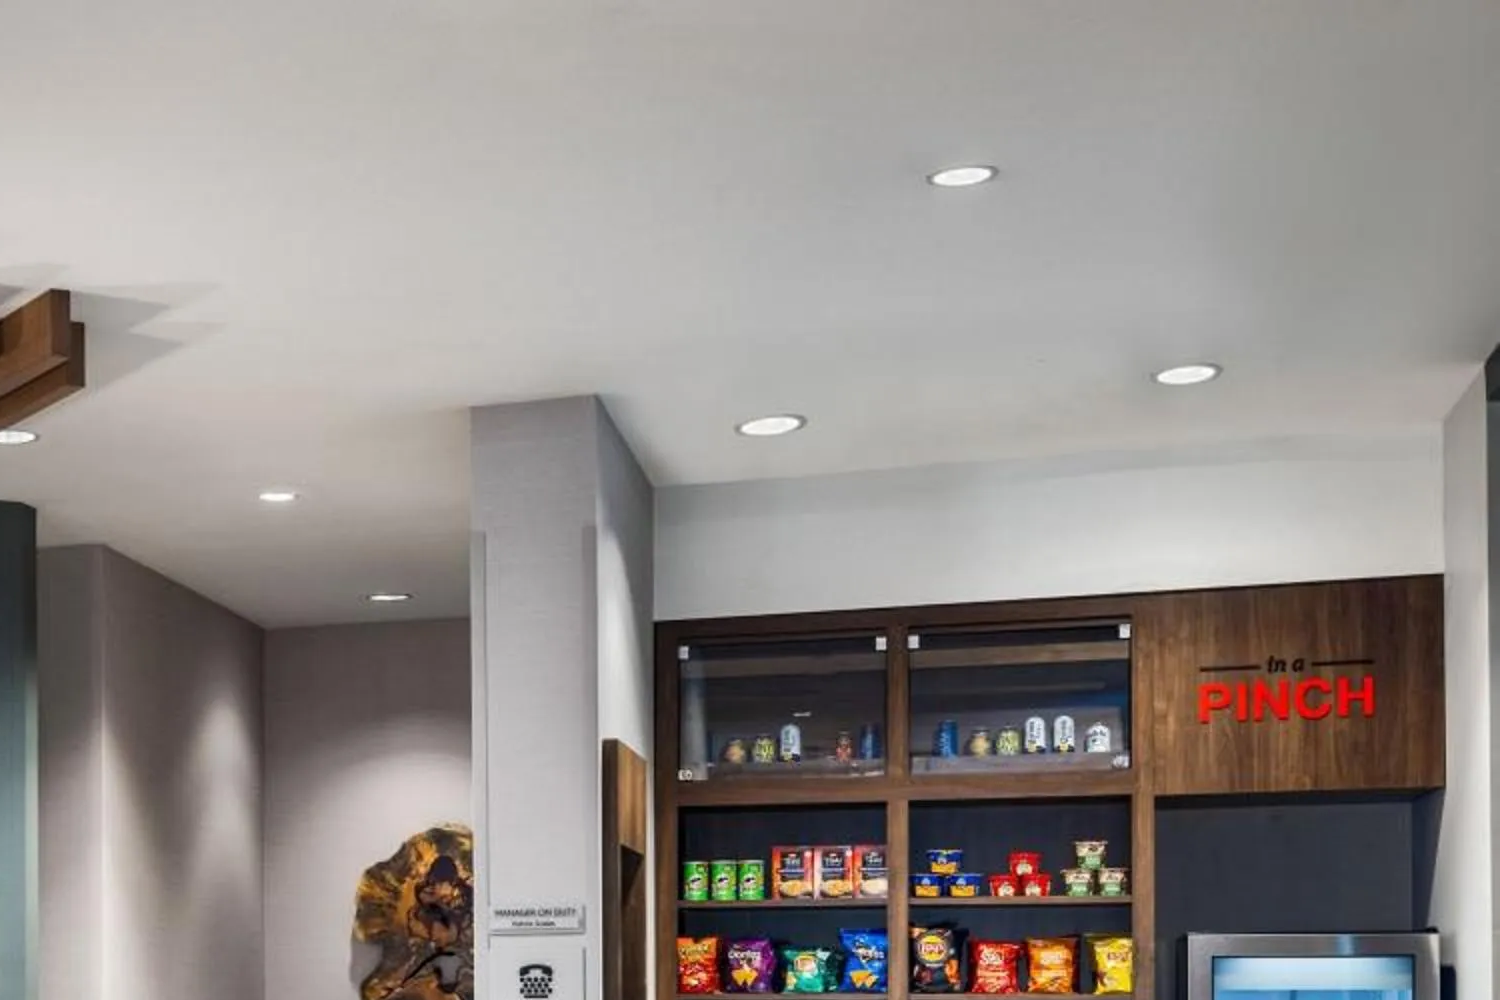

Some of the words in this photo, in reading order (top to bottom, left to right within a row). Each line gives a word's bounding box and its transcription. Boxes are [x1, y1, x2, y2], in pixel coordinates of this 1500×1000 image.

[1267, 655, 1287, 673] in
[1291, 657, 1305, 673] a
[1197, 673, 1376, 724] PINCH
[537, 908, 553, 917] ON
